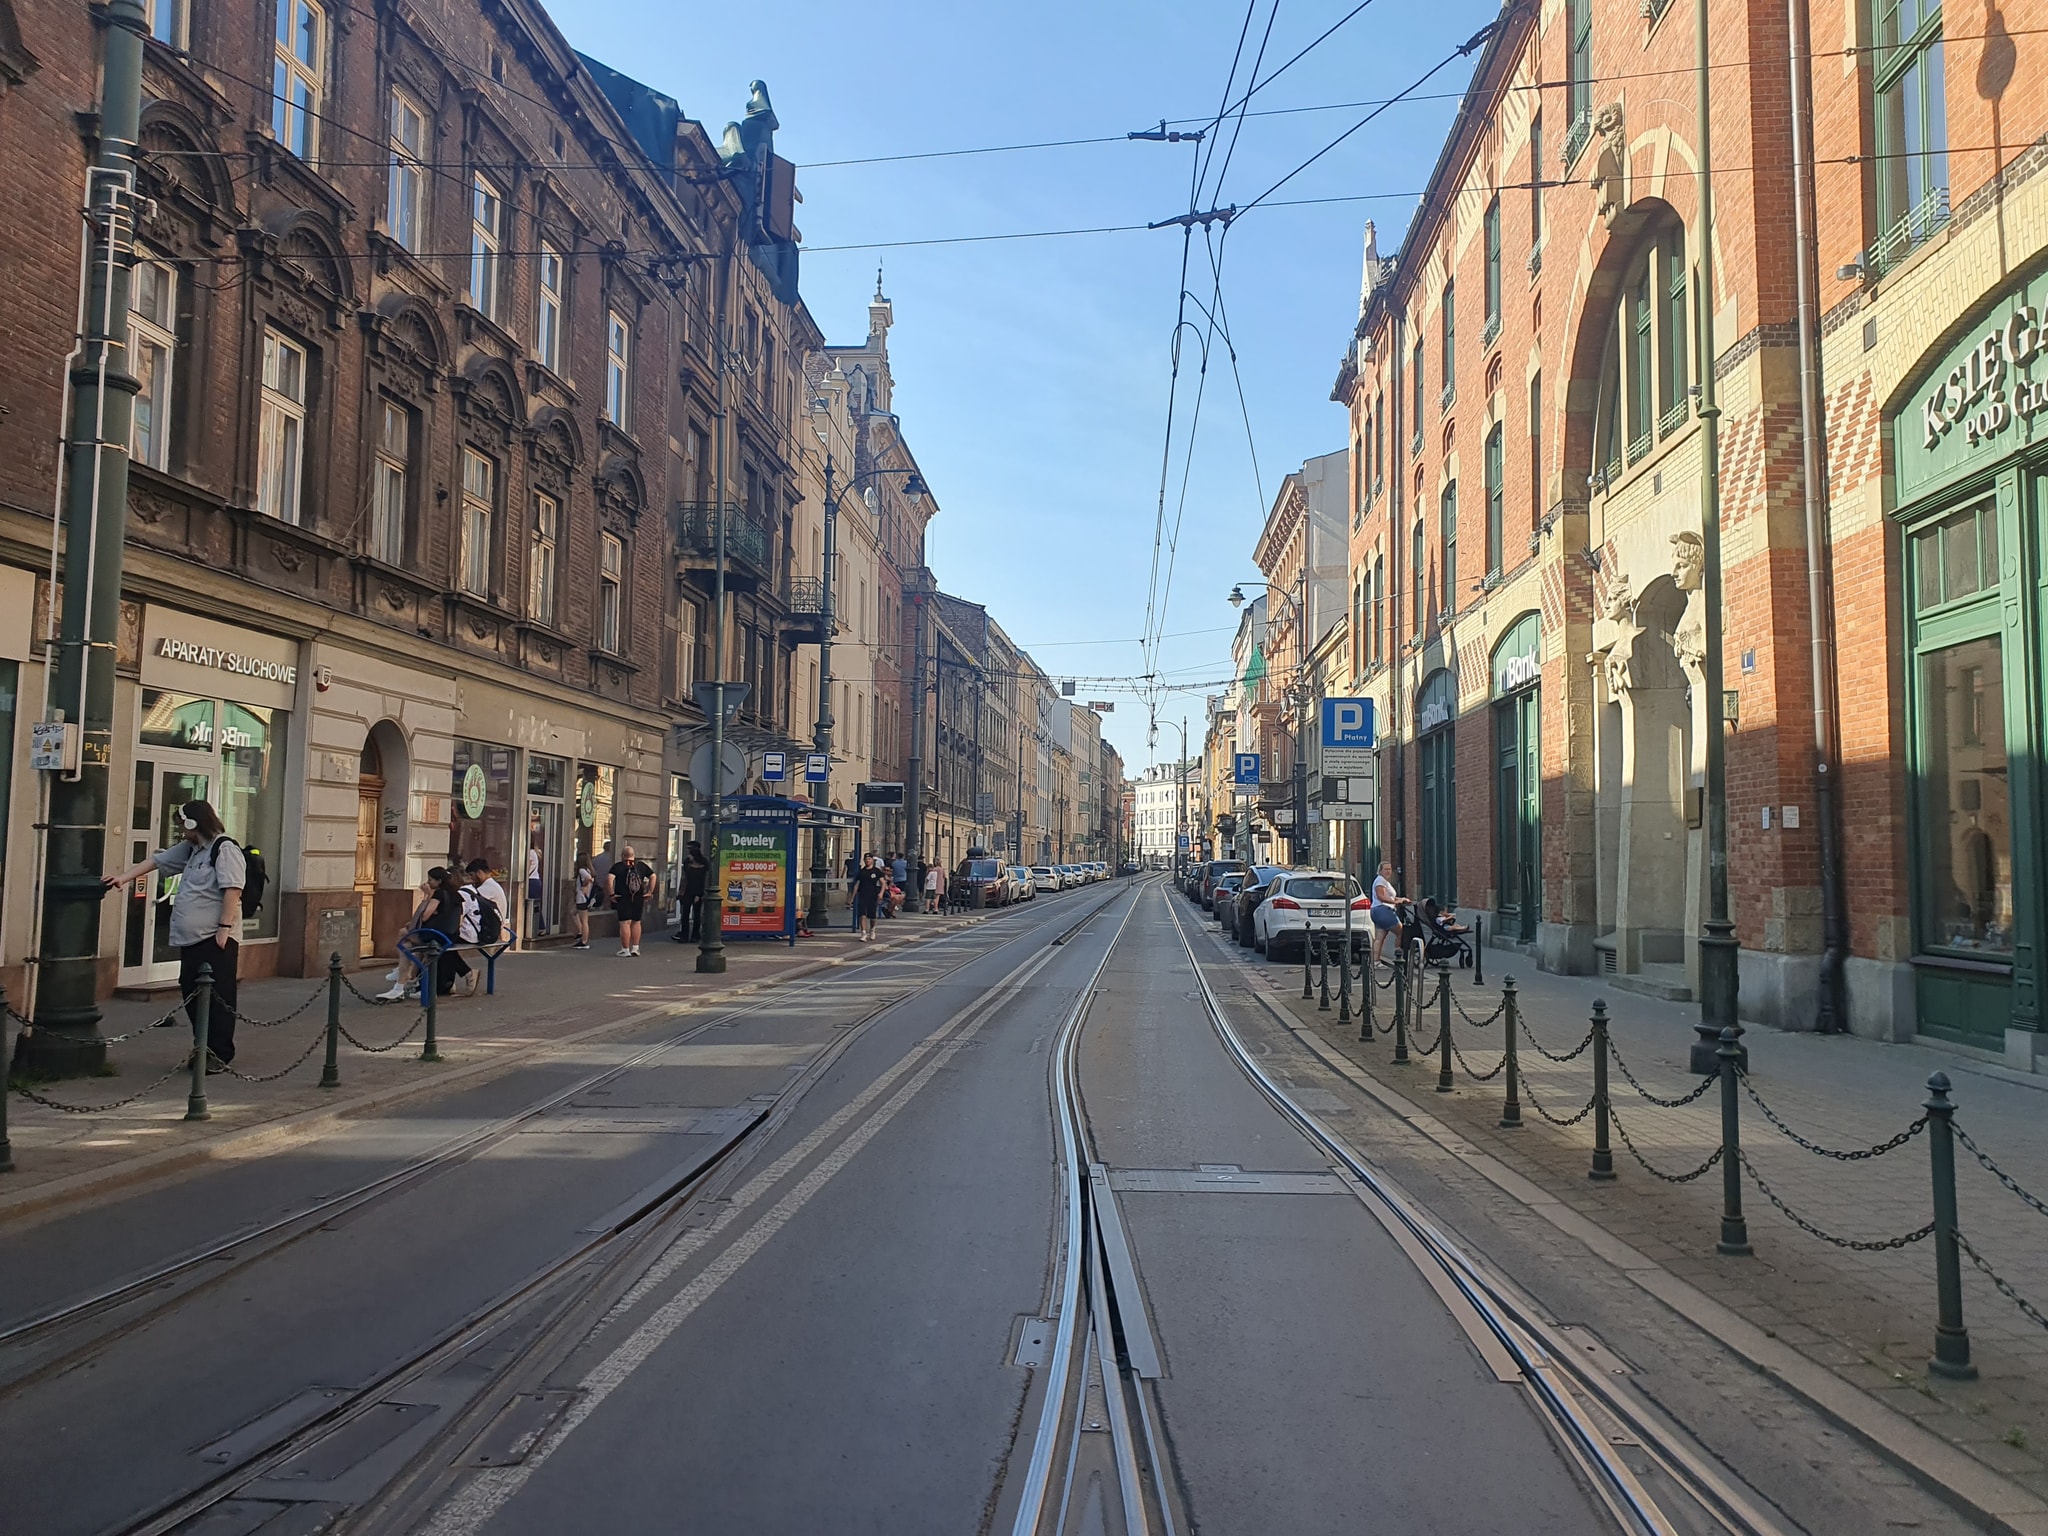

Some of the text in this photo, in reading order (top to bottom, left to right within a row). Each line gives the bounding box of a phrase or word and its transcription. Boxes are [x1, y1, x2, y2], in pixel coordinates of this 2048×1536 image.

[1965, 403, 2004, 444] POD
[160, 638, 297, 684] APARATY SŁUCHOWE
[1499, 644, 1537, 692] mBank
[1334, 703, 1363, 741] P
[1422, 696, 1449, 730] mBank
[85, 742, 100, 752] PL
[1344, 734, 1367, 742] Płatny
[1240, 756, 1255, 775] P
[731, 833, 775, 849] Develey
[1181, 837, 1188, 846] P
[755, 862, 768, 871] 000
